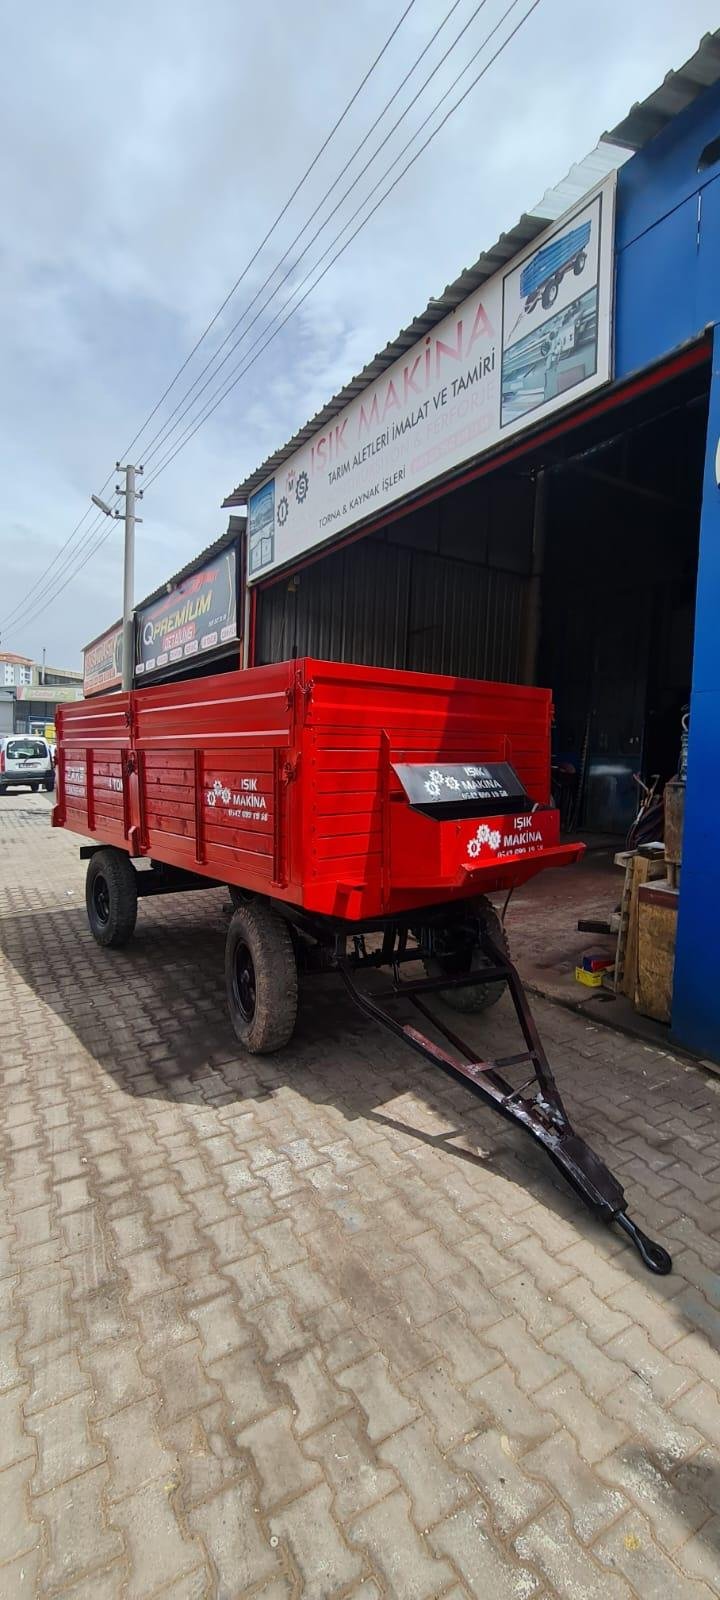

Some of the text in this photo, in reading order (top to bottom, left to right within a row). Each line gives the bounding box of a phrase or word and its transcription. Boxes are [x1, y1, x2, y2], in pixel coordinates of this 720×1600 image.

[328, 459, 350, 485] TARIM
[352, 427, 389, 469] ALETLERİ
[392, 400, 430, 441] İMALAT
[433, 387, 448, 410] VE
[451, 347, 495, 398] TAMİRİ
[319, 511, 341, 528] TORNA
[349, 484, 381, 507] KAYNAK
[382, 464, 406, 493] İŞLERİ
[233, 793, 267, 808] MAKİNA
[514, 816, 532, 830] IŞIK
[503, 830, 542, 847] MAKİNA
